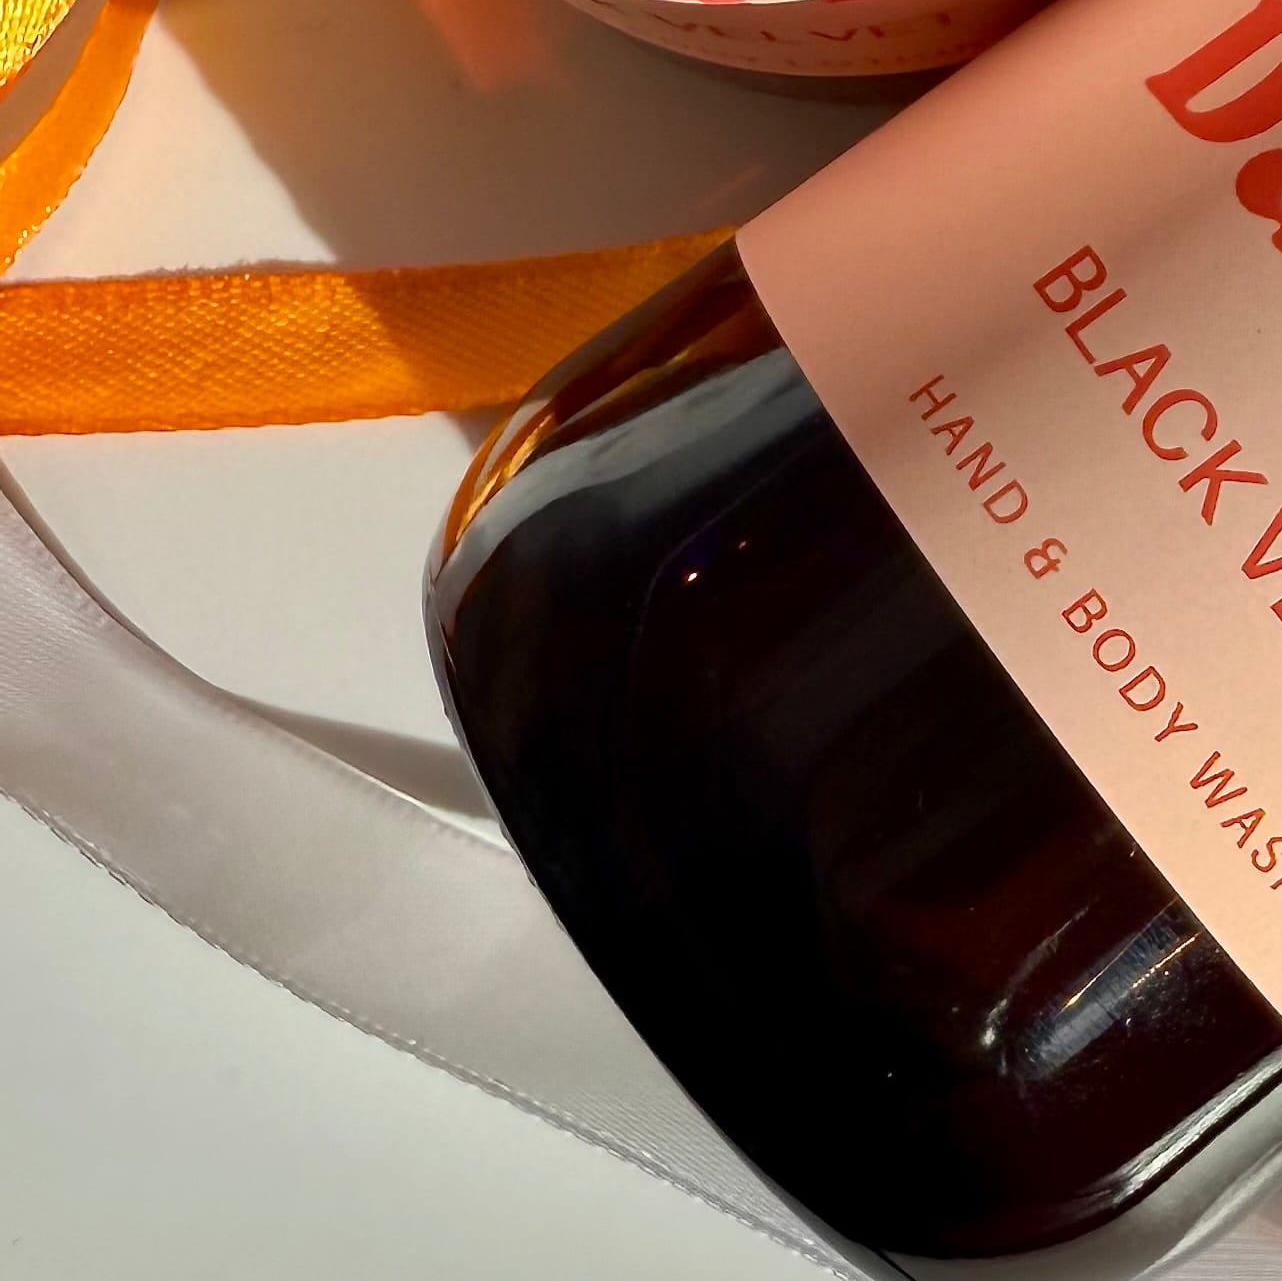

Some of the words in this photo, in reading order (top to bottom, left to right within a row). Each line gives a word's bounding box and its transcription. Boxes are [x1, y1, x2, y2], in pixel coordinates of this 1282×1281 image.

[1033, 245, 1268, 526] BLACK
[910, 375, 1030, 525] HAND
[1023, 537, 1067, 580] &
[1060, 588, 1199, 744] BODY
